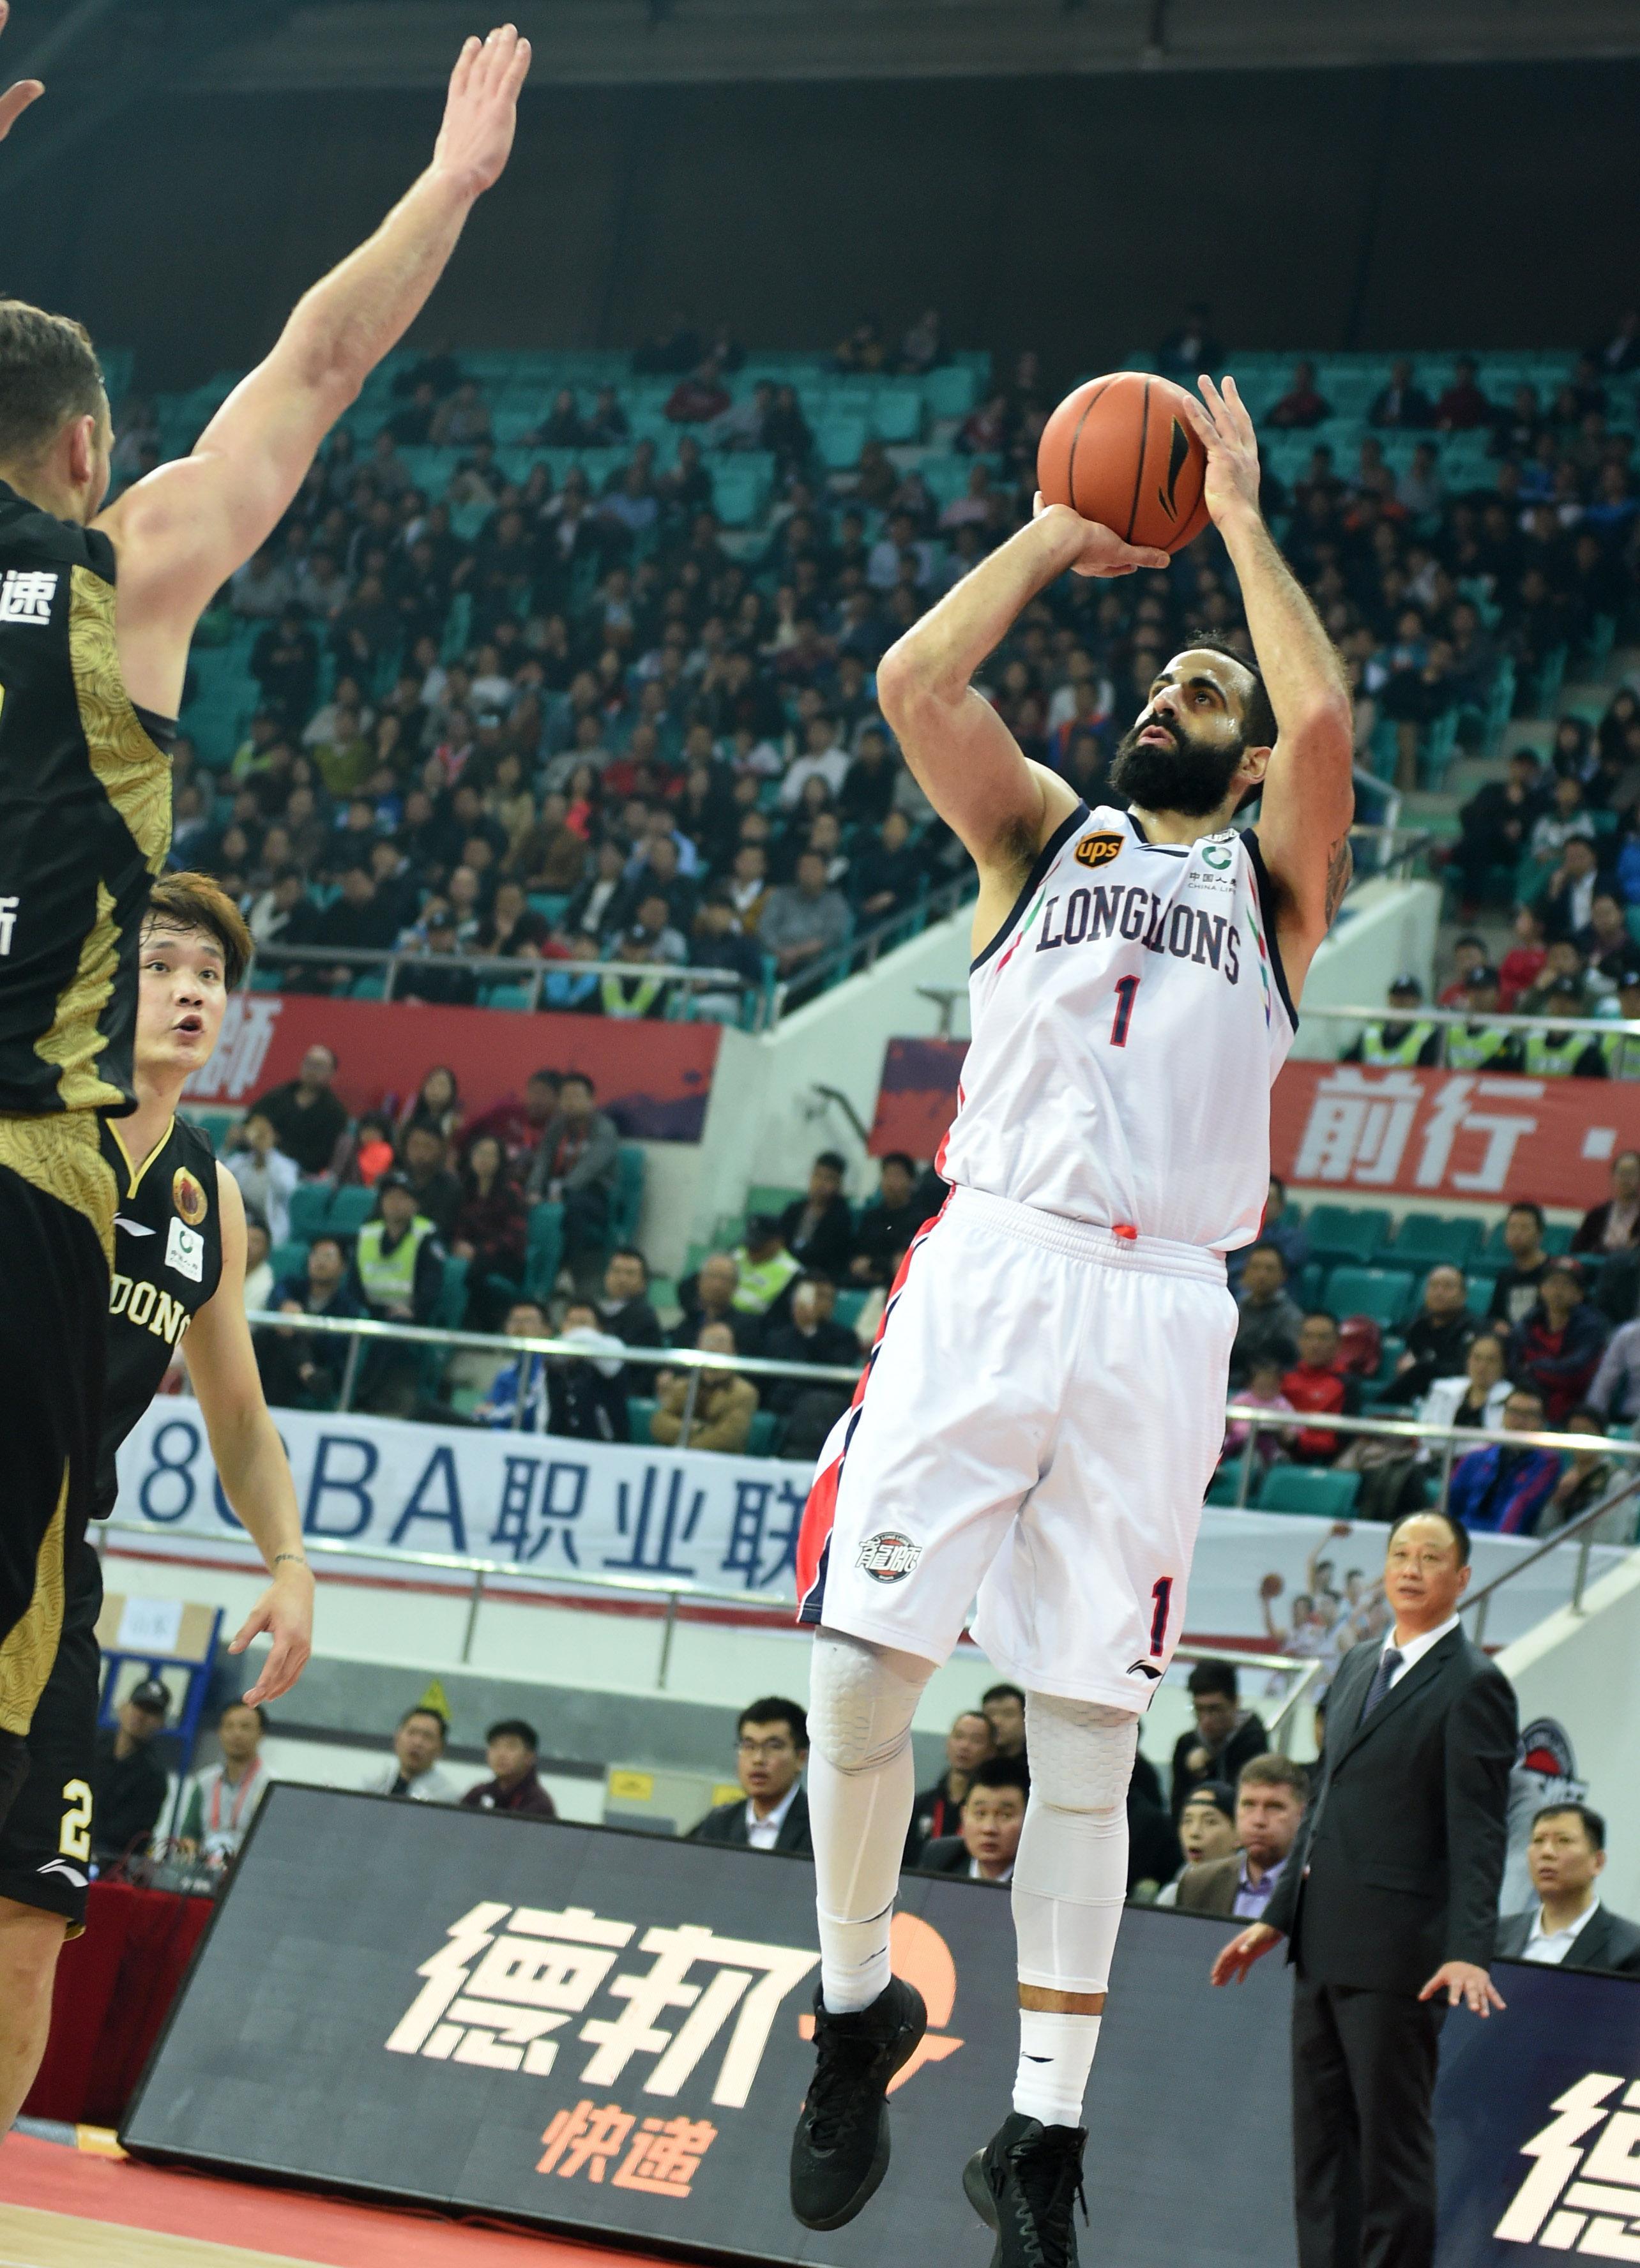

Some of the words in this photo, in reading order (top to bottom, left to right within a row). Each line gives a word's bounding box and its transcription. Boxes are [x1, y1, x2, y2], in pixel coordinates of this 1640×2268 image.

[0, 570, 58, 625] 速
[1078, 842, 1119, 863] ups
[1110, 974, 1141, 1048] 1
[1150, 1576, 1173, 1657] 1
[59, 1778, 93, 1863] 2
[386, 1900, 821, 2109] 德邦
[536, 2099, 718, 2198] 快递
